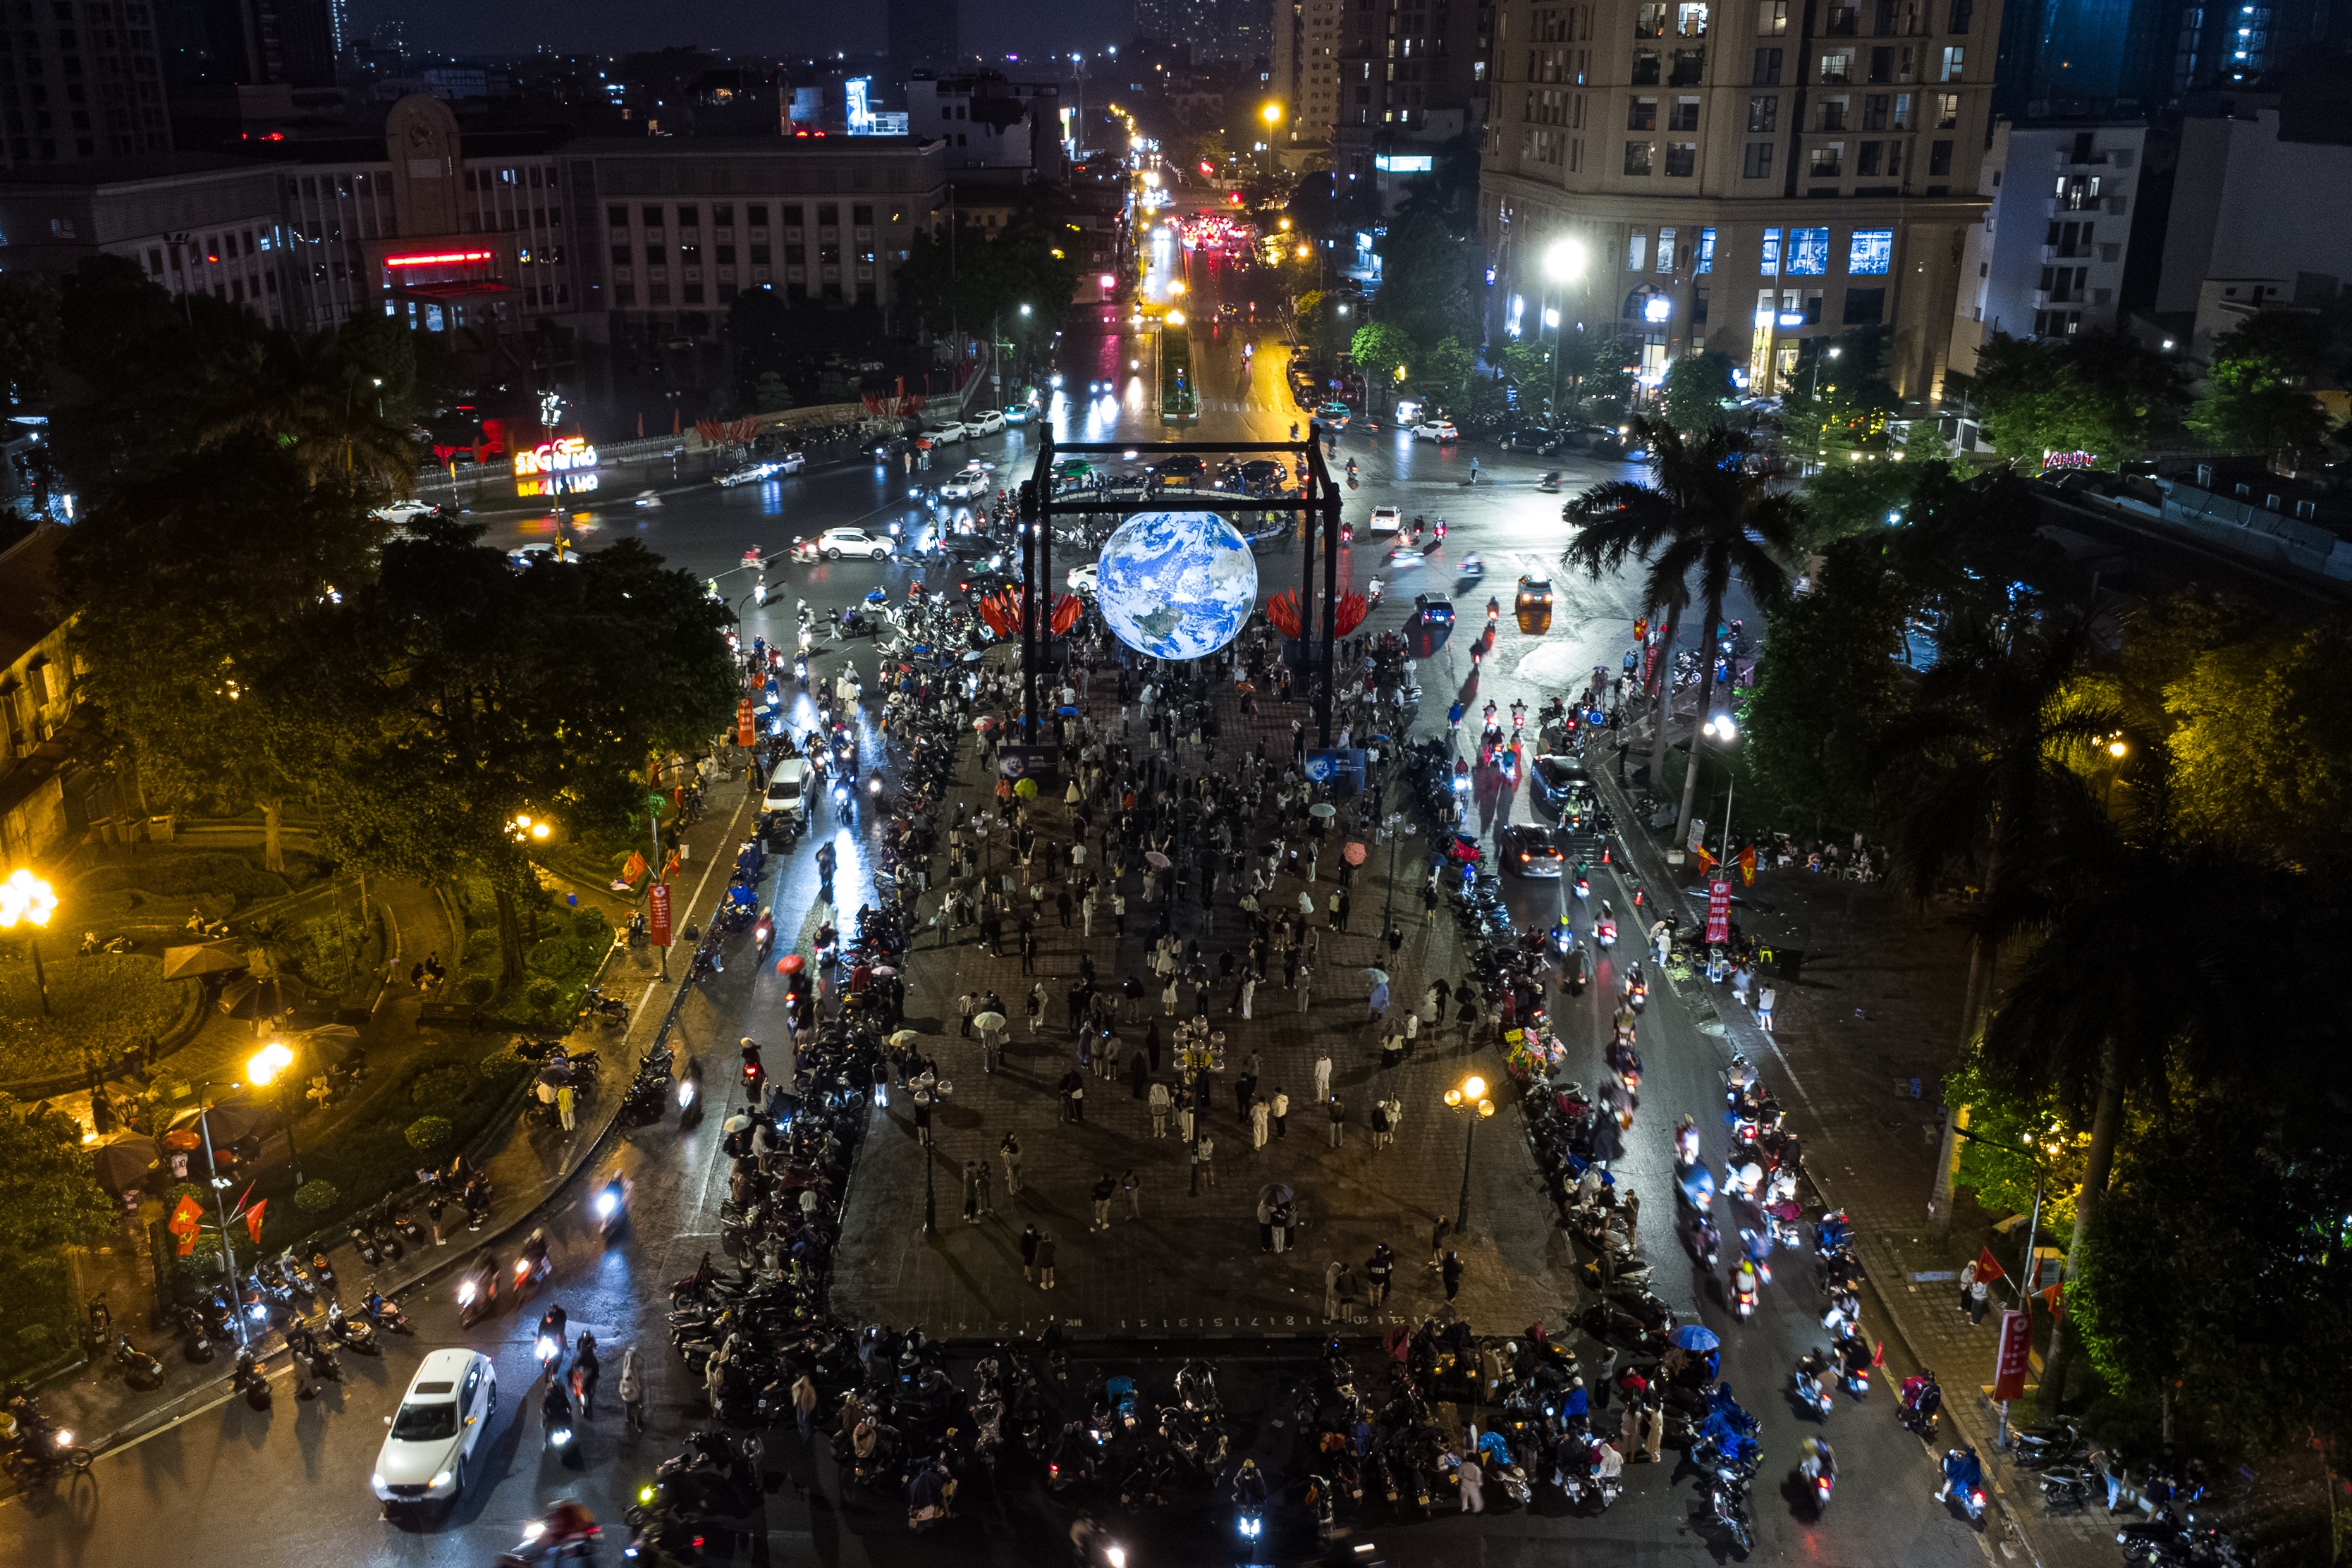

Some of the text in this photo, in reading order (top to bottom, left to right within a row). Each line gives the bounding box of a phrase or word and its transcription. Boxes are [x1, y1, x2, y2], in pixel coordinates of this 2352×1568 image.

[1178, 1318, 1188, 1327] 3
[1213, 1318, 1223, 1327] 5
[1251, 1317, 1258, 1326] 7
[1285, 1316, 1294, 1325] 8
[1353, 1316, 1369, 1324] 10
[998, 1322, 1009, 1331] 2
